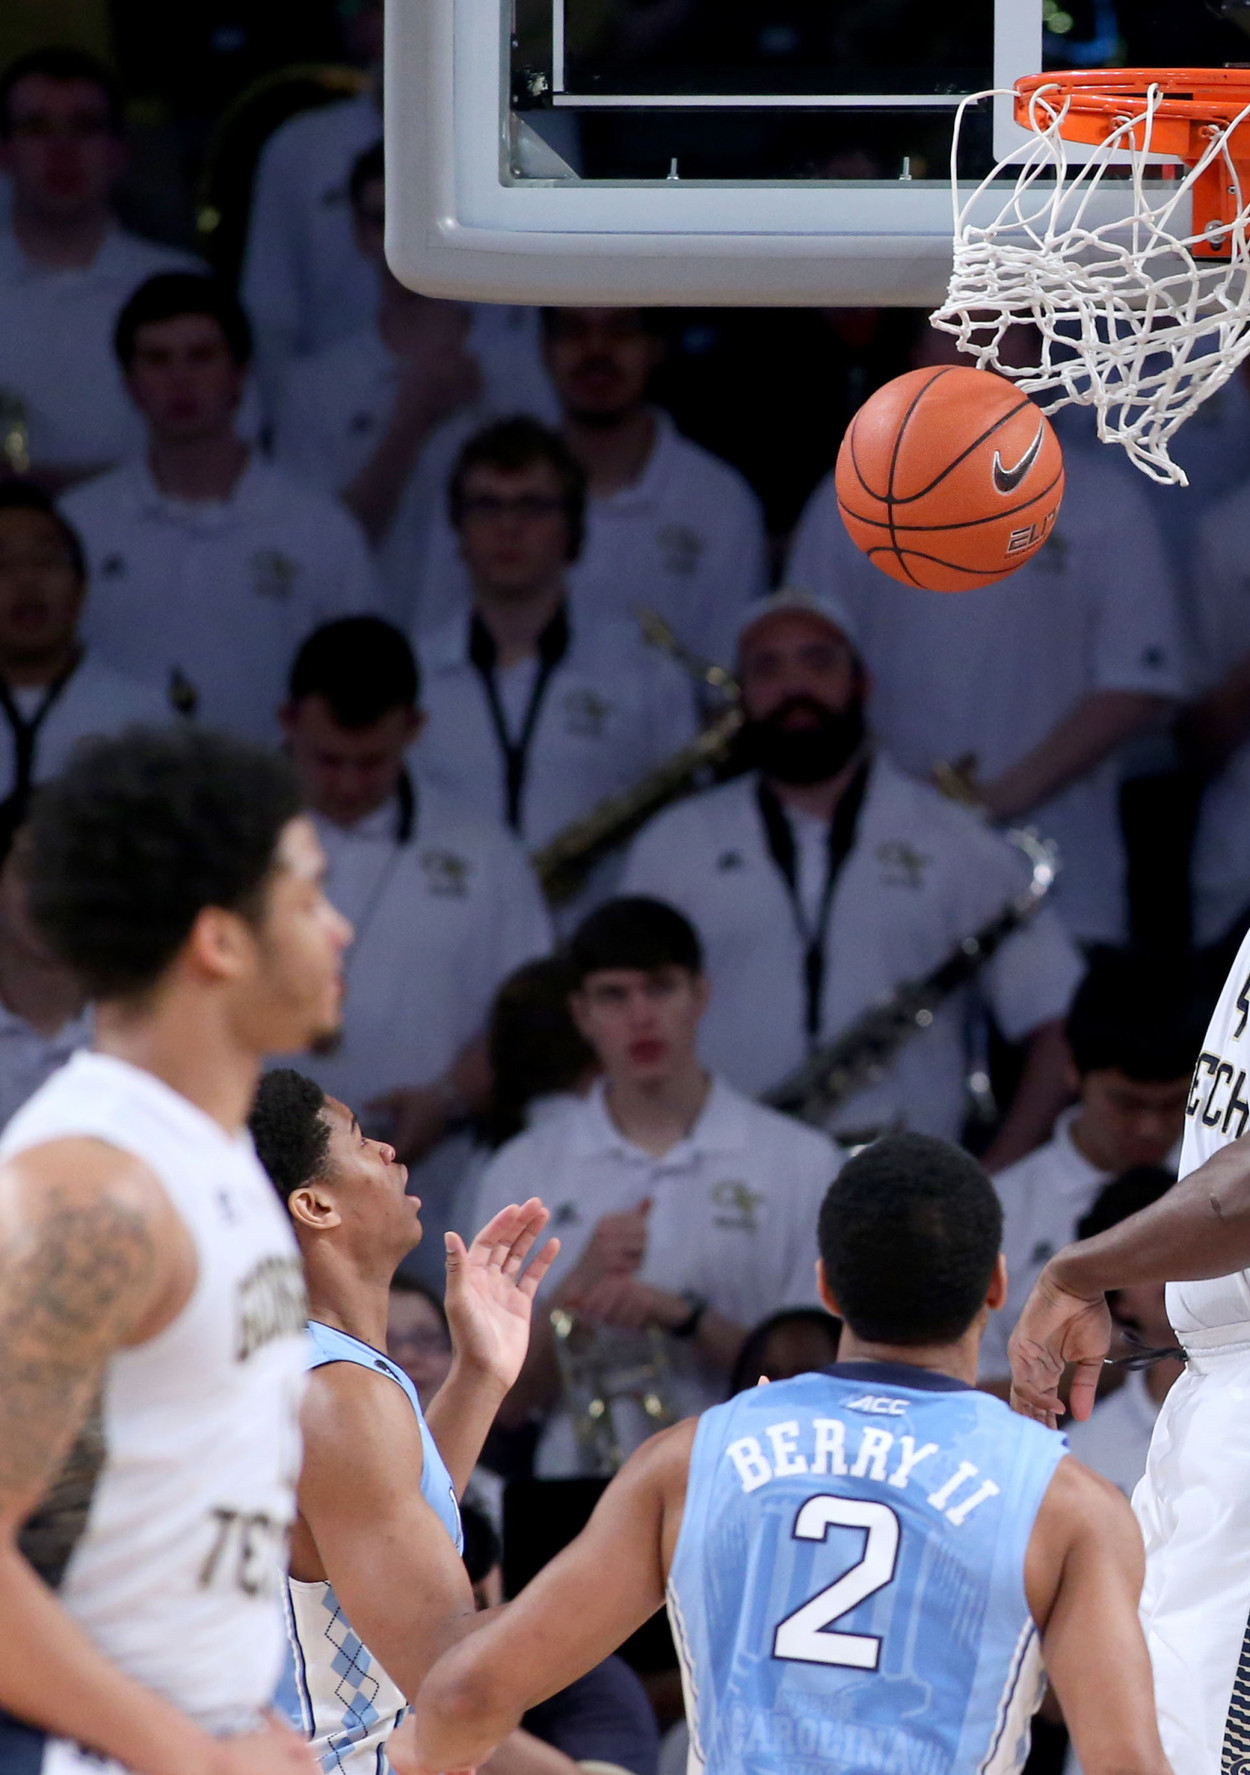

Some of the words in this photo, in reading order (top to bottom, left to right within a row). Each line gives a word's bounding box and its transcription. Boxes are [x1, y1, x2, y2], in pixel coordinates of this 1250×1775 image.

[846, 1395, 911, 1415] ACC
[726, 1417, 939, 1493] BERRY
[926, 1460, 1000, 1526] II
[771, 1493, 902, 1672] 2
